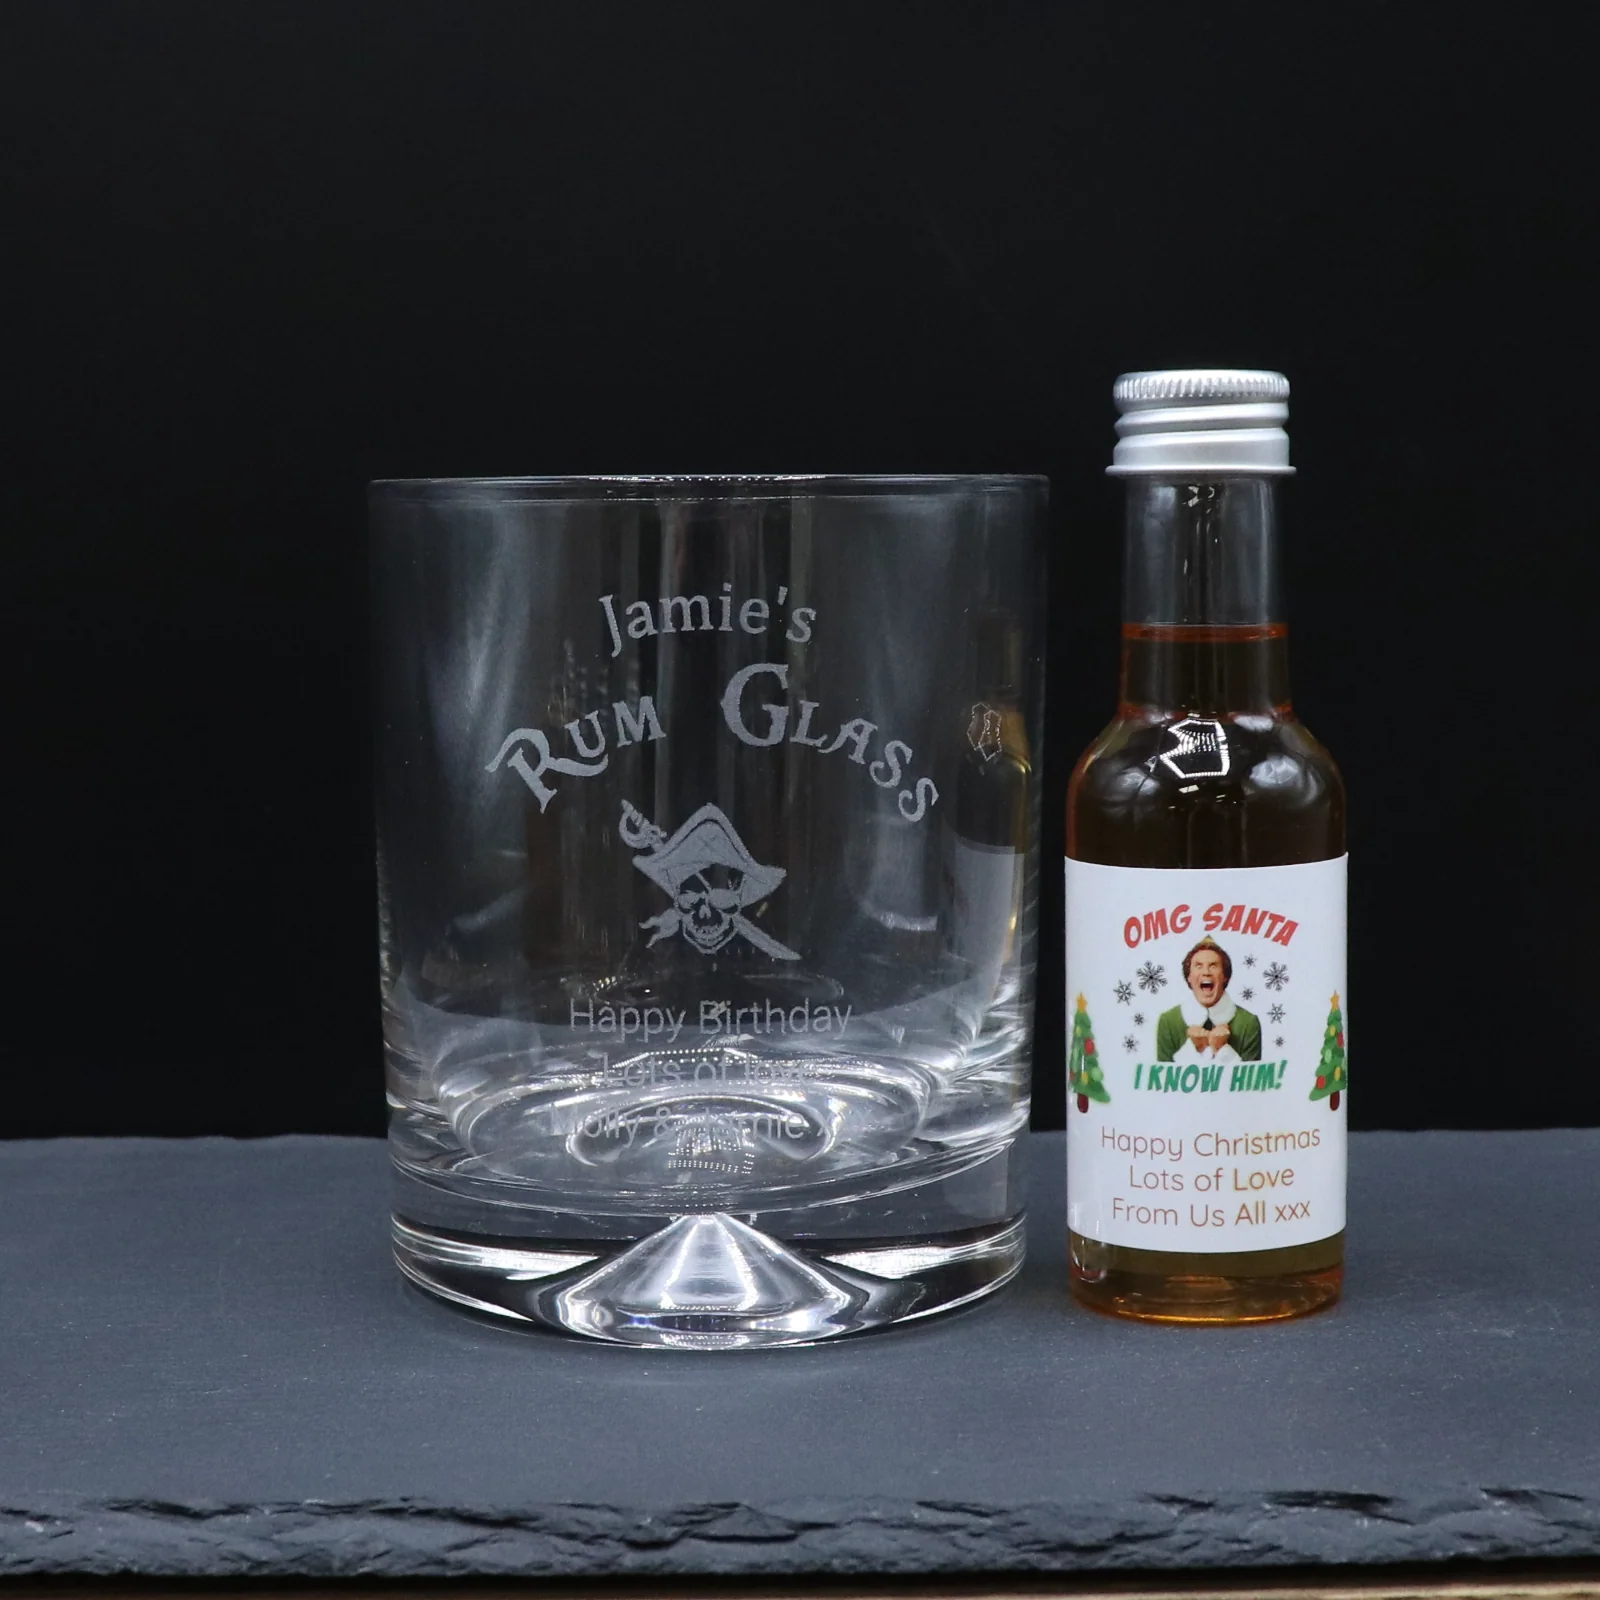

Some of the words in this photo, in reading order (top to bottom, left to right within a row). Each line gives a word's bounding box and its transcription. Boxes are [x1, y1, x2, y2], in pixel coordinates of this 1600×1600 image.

[600, 582, 817, 658] Jamie's
[485, 696, 667, 814] RUM
[720, 662, 940, 823] GLASS
[1123, 903, 1193, 949] OMG
[1202, 902, 1299, 947] SANTA
[569, 998, 687, 1044] Happy
[699, 997, 853, 1040] Birthday
[603, 1052, 682, 1088] Lots
[694, 1052, 731, 1087] of
[1133, 1063, 1144, 1090] I
[1147, 1063, 1225, 1093] KNOW
[1229, 1059, 1288, 1092] HIM!
[551, 1101, 641, 1149] Molly
[1101, 1126, 1183, 1162] Happy
[1193, 1128, 1321, 1157] Christmas
[1130, 1165, 1184, 1192] Lots
[1194, 1167, 1224, 1192] of
[1233, 1167, 1295, 1192] Love
[1112, 1197, 1178, 1226] From
[1189, 1204, 1225, 1228] Us
[1234, 1200, 1266, 1226] All
[1274, 1200, 1311, 1224] xxx
